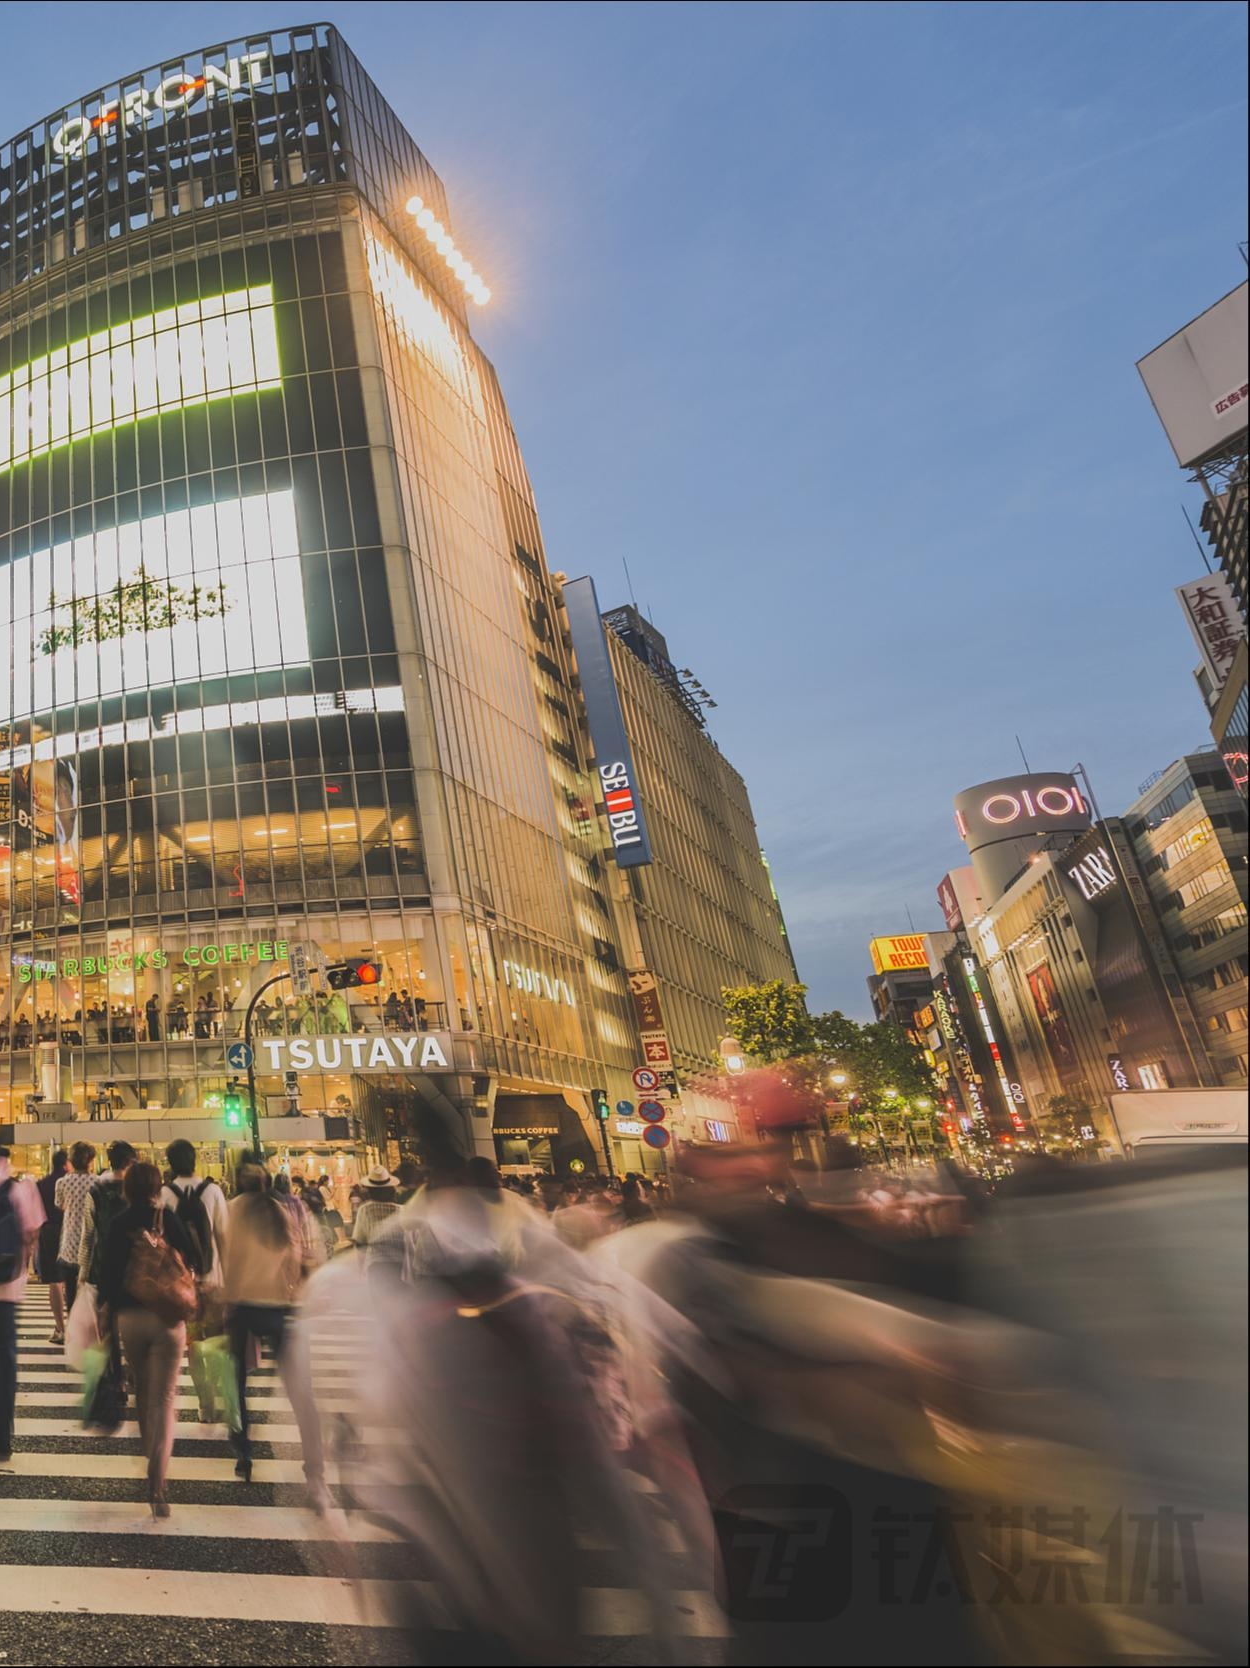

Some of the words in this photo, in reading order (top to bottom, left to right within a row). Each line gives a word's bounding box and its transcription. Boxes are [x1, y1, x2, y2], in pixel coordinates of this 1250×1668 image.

[19, 947, 169, 983] STARBUCKS
[183, 939, 289, 967] COFFEE
[263, 1036, 448, 1070] TSUTAYA
[1109, 1060, 1130, 1091] ZAR
